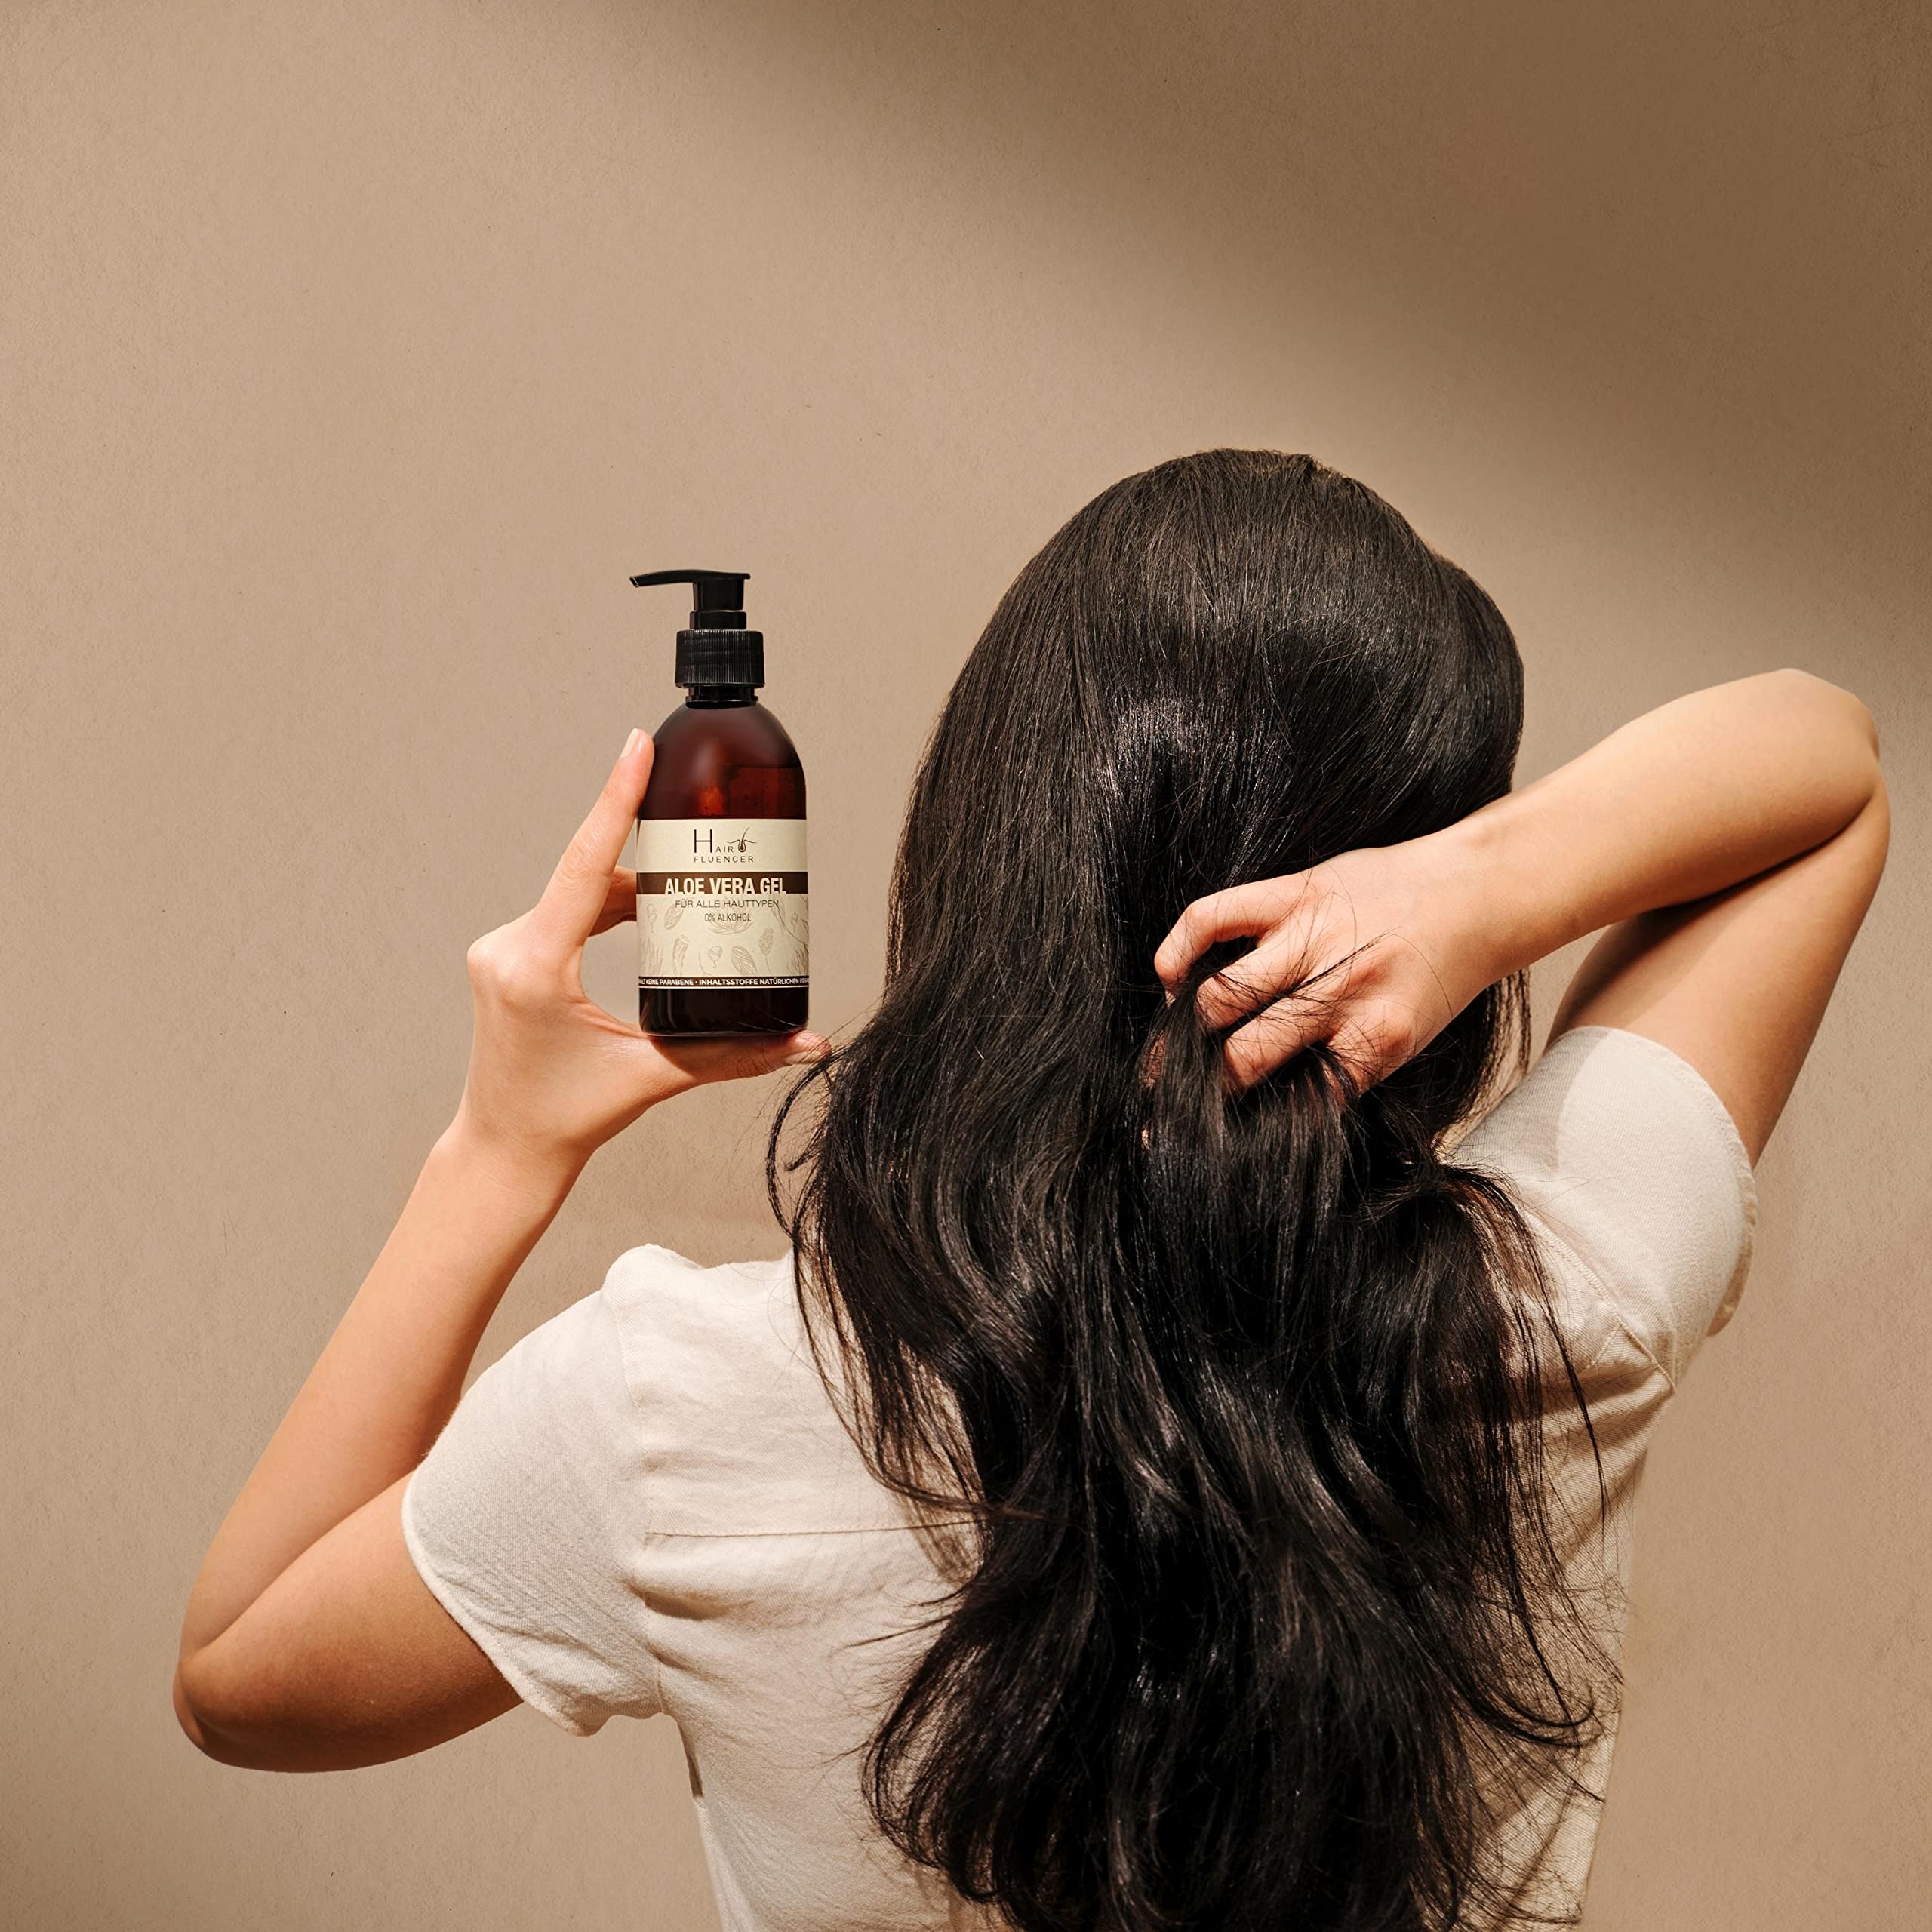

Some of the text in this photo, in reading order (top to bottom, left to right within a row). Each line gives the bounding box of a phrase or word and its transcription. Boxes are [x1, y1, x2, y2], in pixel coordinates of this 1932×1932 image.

[665, 878, 786, 894] ALOE VERA GEL
[675, 898, 779, 908] FÜR ALLE HAUTTYPEN
[704, 913, 752, 921] 0% ALKOHOL
